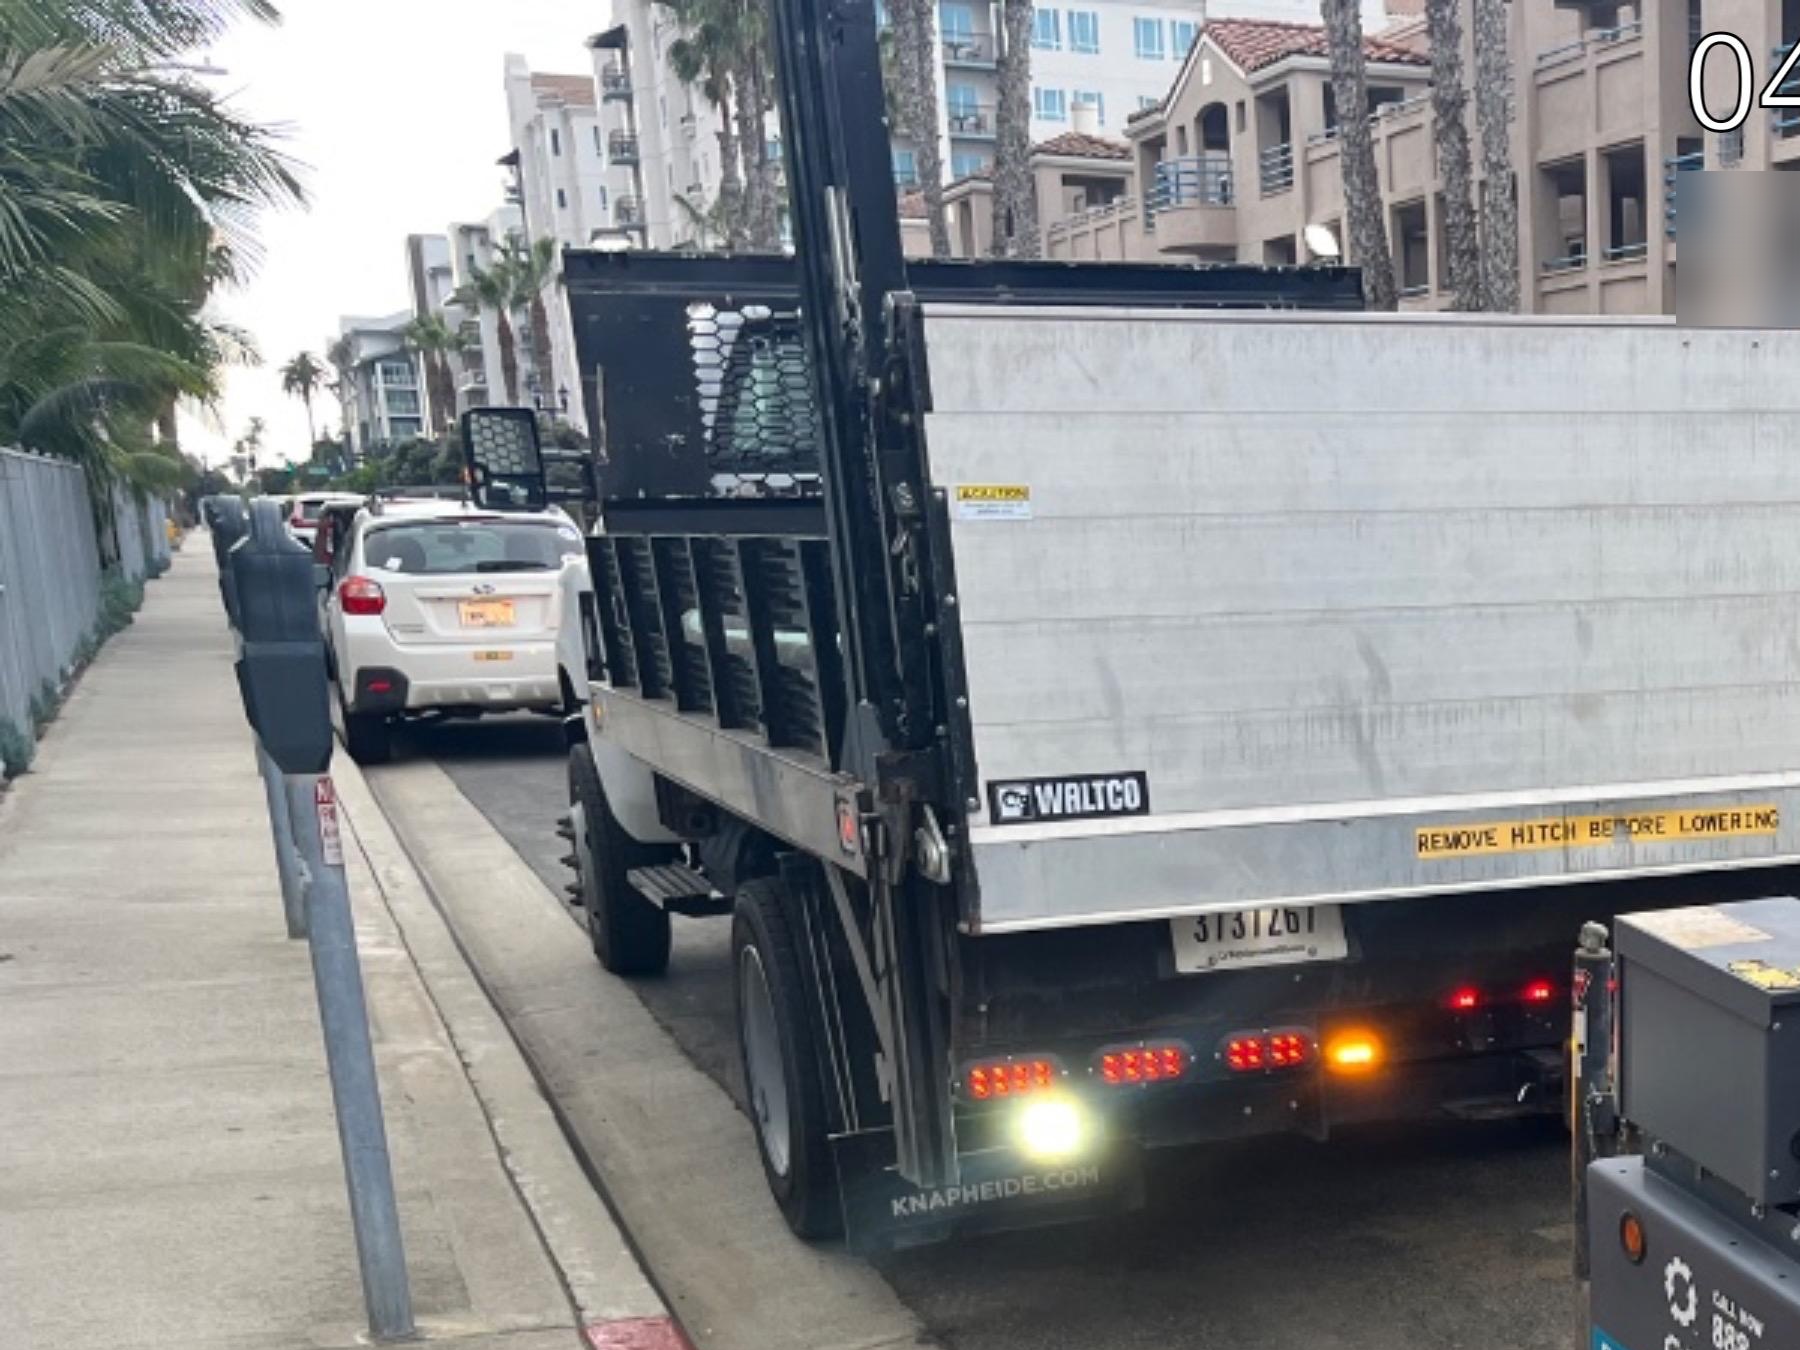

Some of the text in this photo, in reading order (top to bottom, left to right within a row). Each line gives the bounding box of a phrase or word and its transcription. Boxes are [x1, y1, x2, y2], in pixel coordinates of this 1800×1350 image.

[1034, 776, 1141, 814] WALTCO
[1417, 827, 1498, 853] REMOVE
[1511, 820, 1577, 844] HITCH
[1679, 808, 1780, 833] LOWERING
[891, 1165, 1100, 1216] KNAPHEIDE.COM
[1712, 1289, 1764, 1338] CALL NOW
